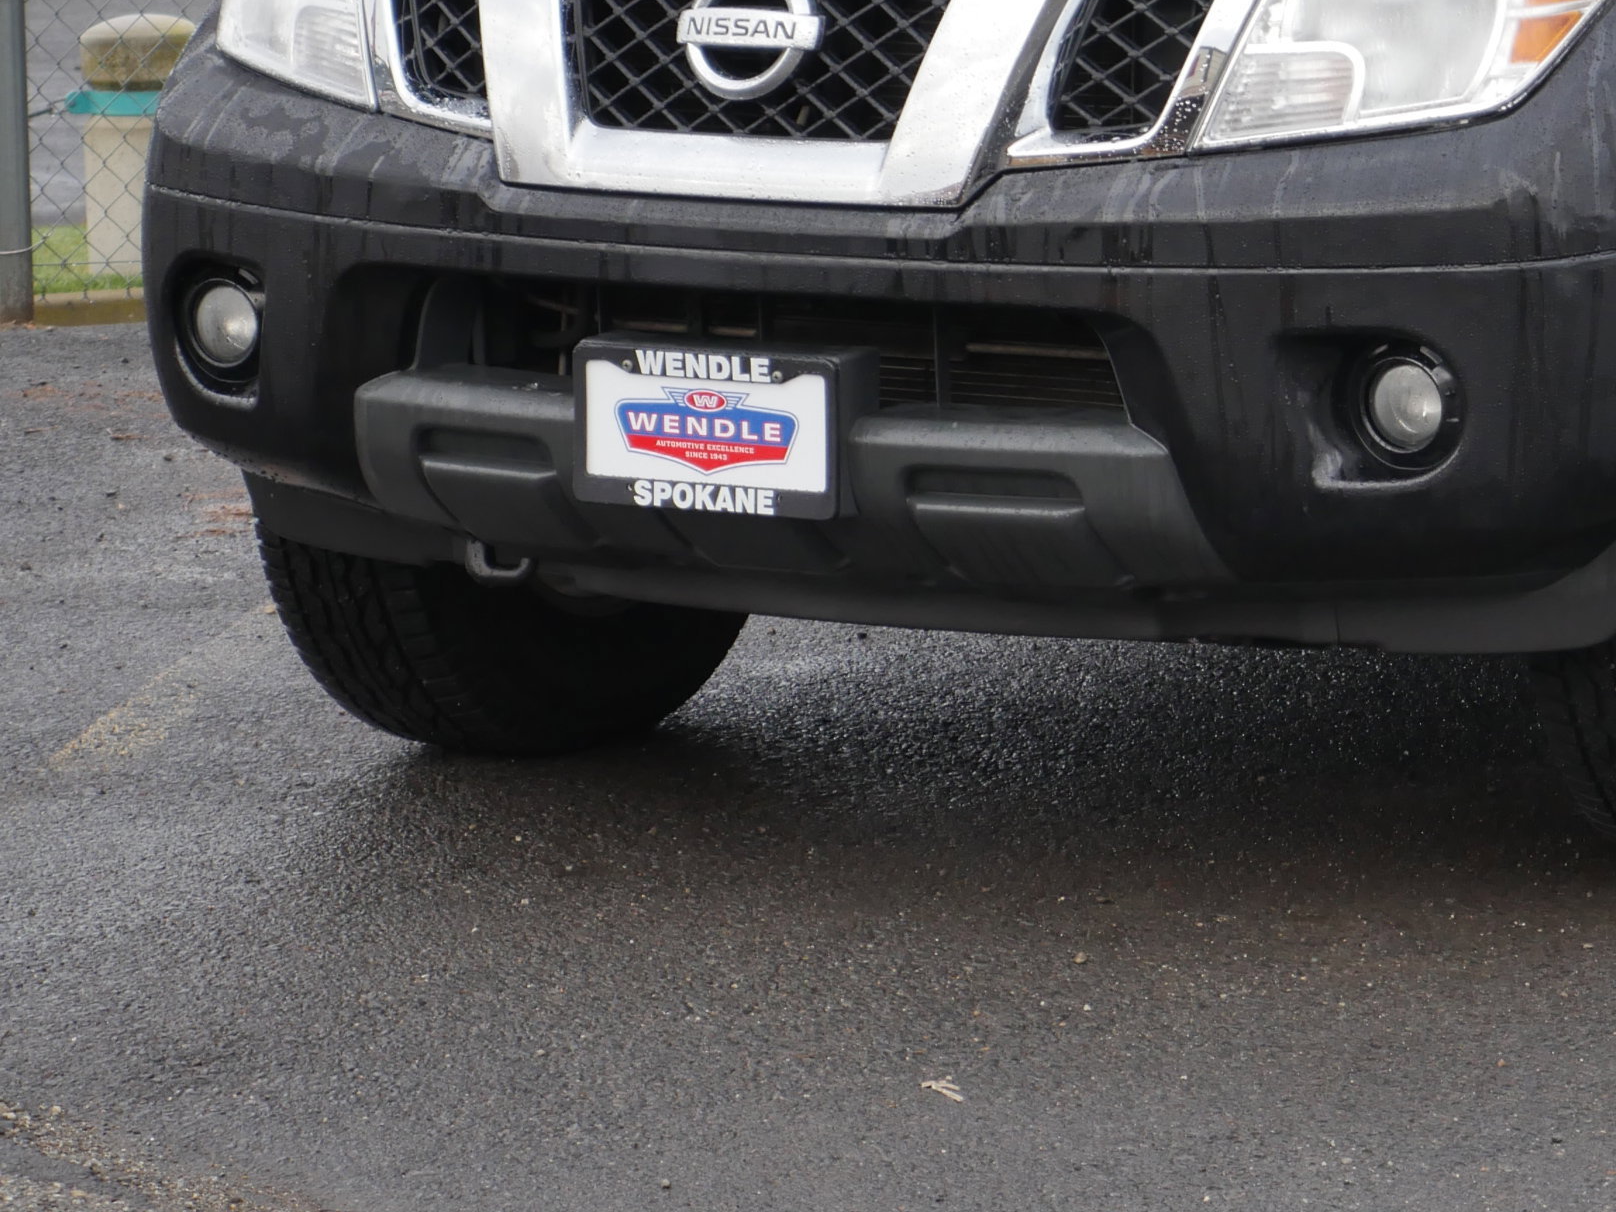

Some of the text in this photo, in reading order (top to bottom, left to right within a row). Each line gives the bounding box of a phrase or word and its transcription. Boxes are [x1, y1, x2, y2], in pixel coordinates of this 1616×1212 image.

[687, 17, 796, 40] NISSAN
[634, 350, 771, 383] WENDLE
[627, 411, 781, 442] WENDLE
[655, 439, 755, 455] AUTOMOTIVE EXCELLENCE
[685, 451, 728, 461] SINCE 1943
[633, 480, 774, 515] SPOKANE
